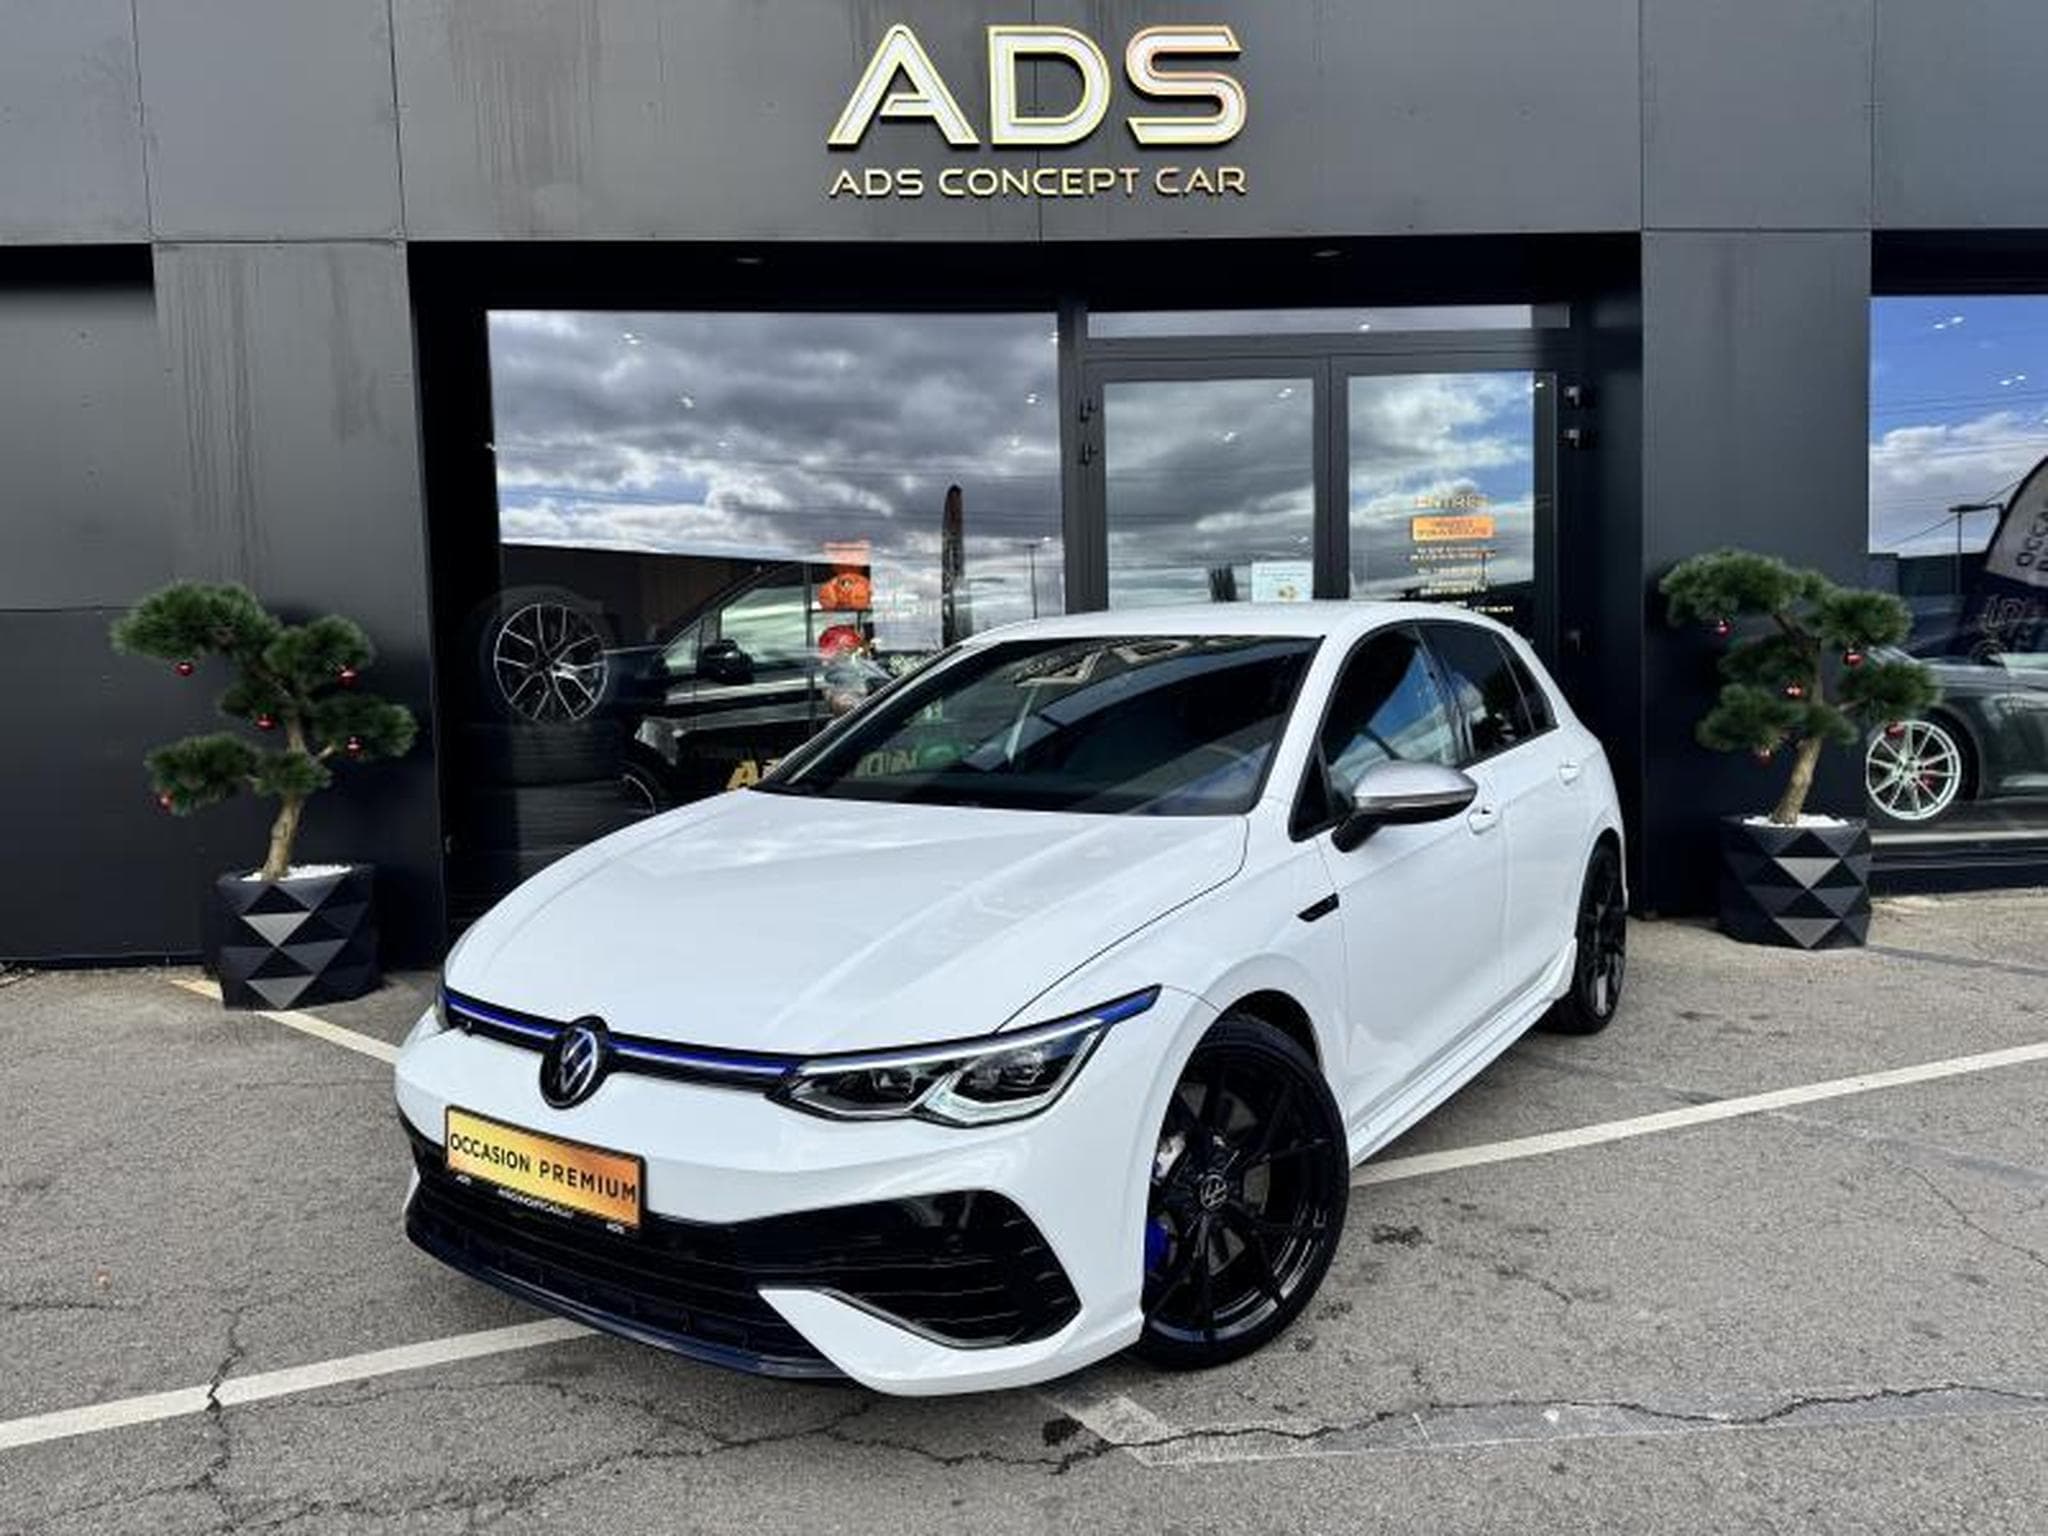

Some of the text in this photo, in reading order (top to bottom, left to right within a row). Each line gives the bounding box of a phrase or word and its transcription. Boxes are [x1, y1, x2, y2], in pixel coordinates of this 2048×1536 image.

[828, 23, 1248, 147] ADS
[829, 167, 1247, 197] ADS CONCEPT CAR
[450, 1133, 532, 1173] OCCASION
[539, 1160, 637, 1204] PREMIUM
